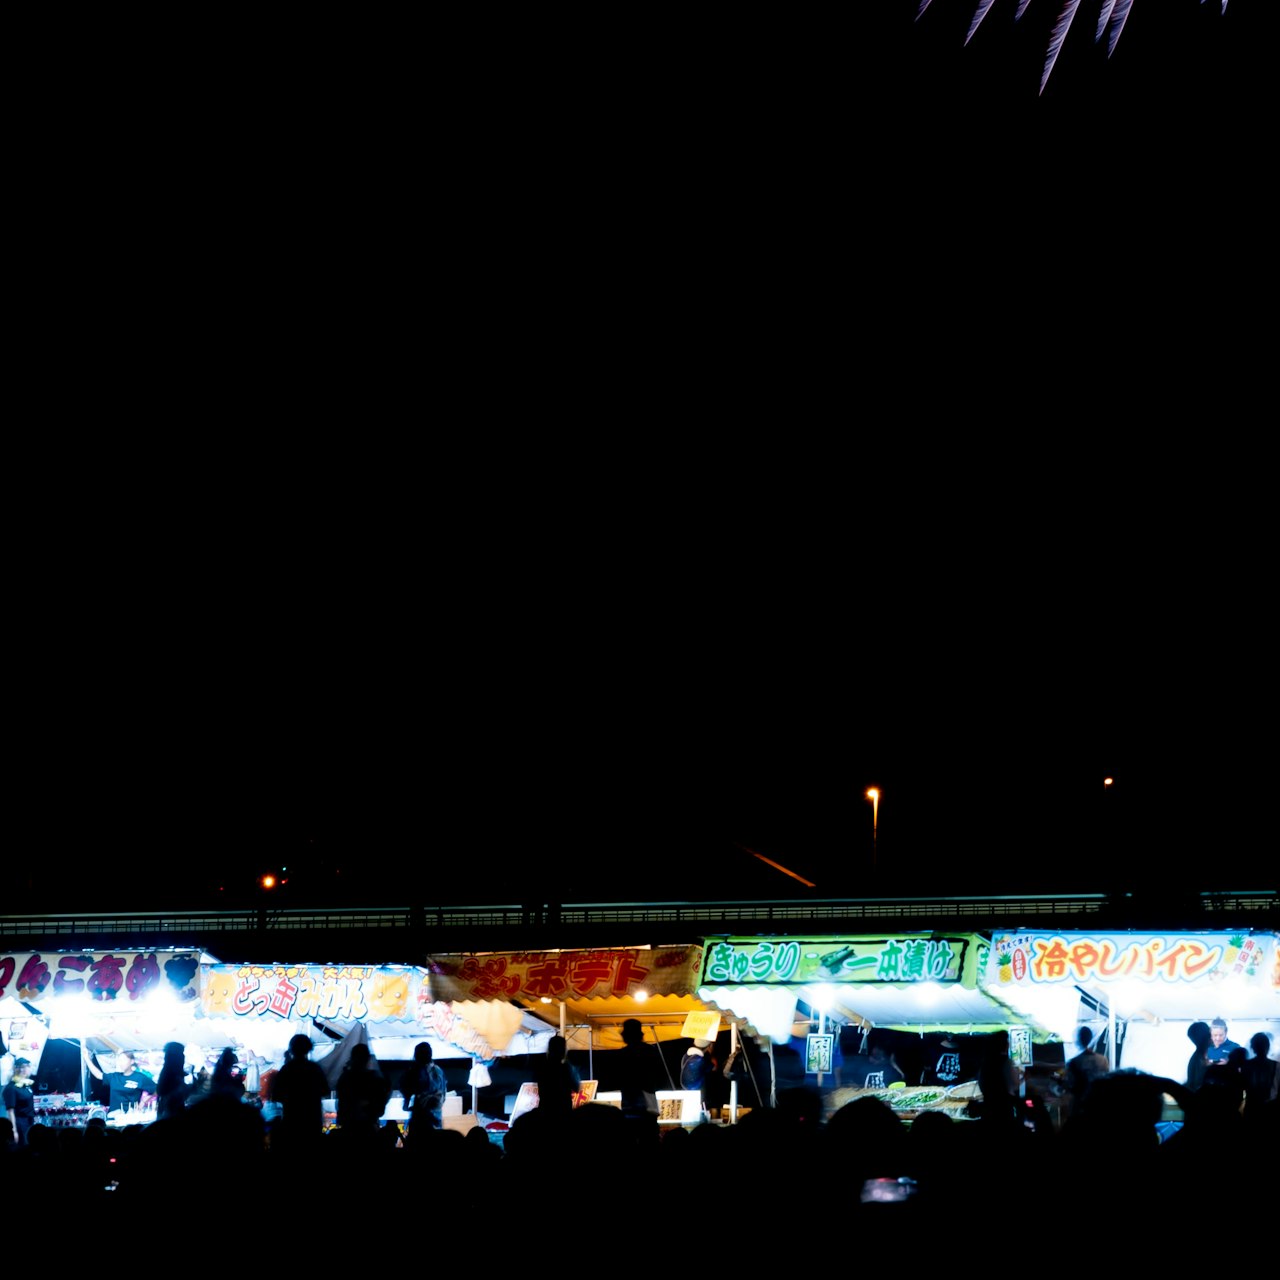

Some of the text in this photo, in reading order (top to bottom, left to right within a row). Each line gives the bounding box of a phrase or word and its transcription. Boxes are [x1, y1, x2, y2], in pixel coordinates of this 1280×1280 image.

[519, 958, 651, 997] ポテト
[707, 942, 800, 981] きゅうり
[845, 939, 953, 981] 一本漬け
[1032, 939, 1218, 979] 冷やしパイン
[232, 978, 368, 1019] どっ缶みかん
